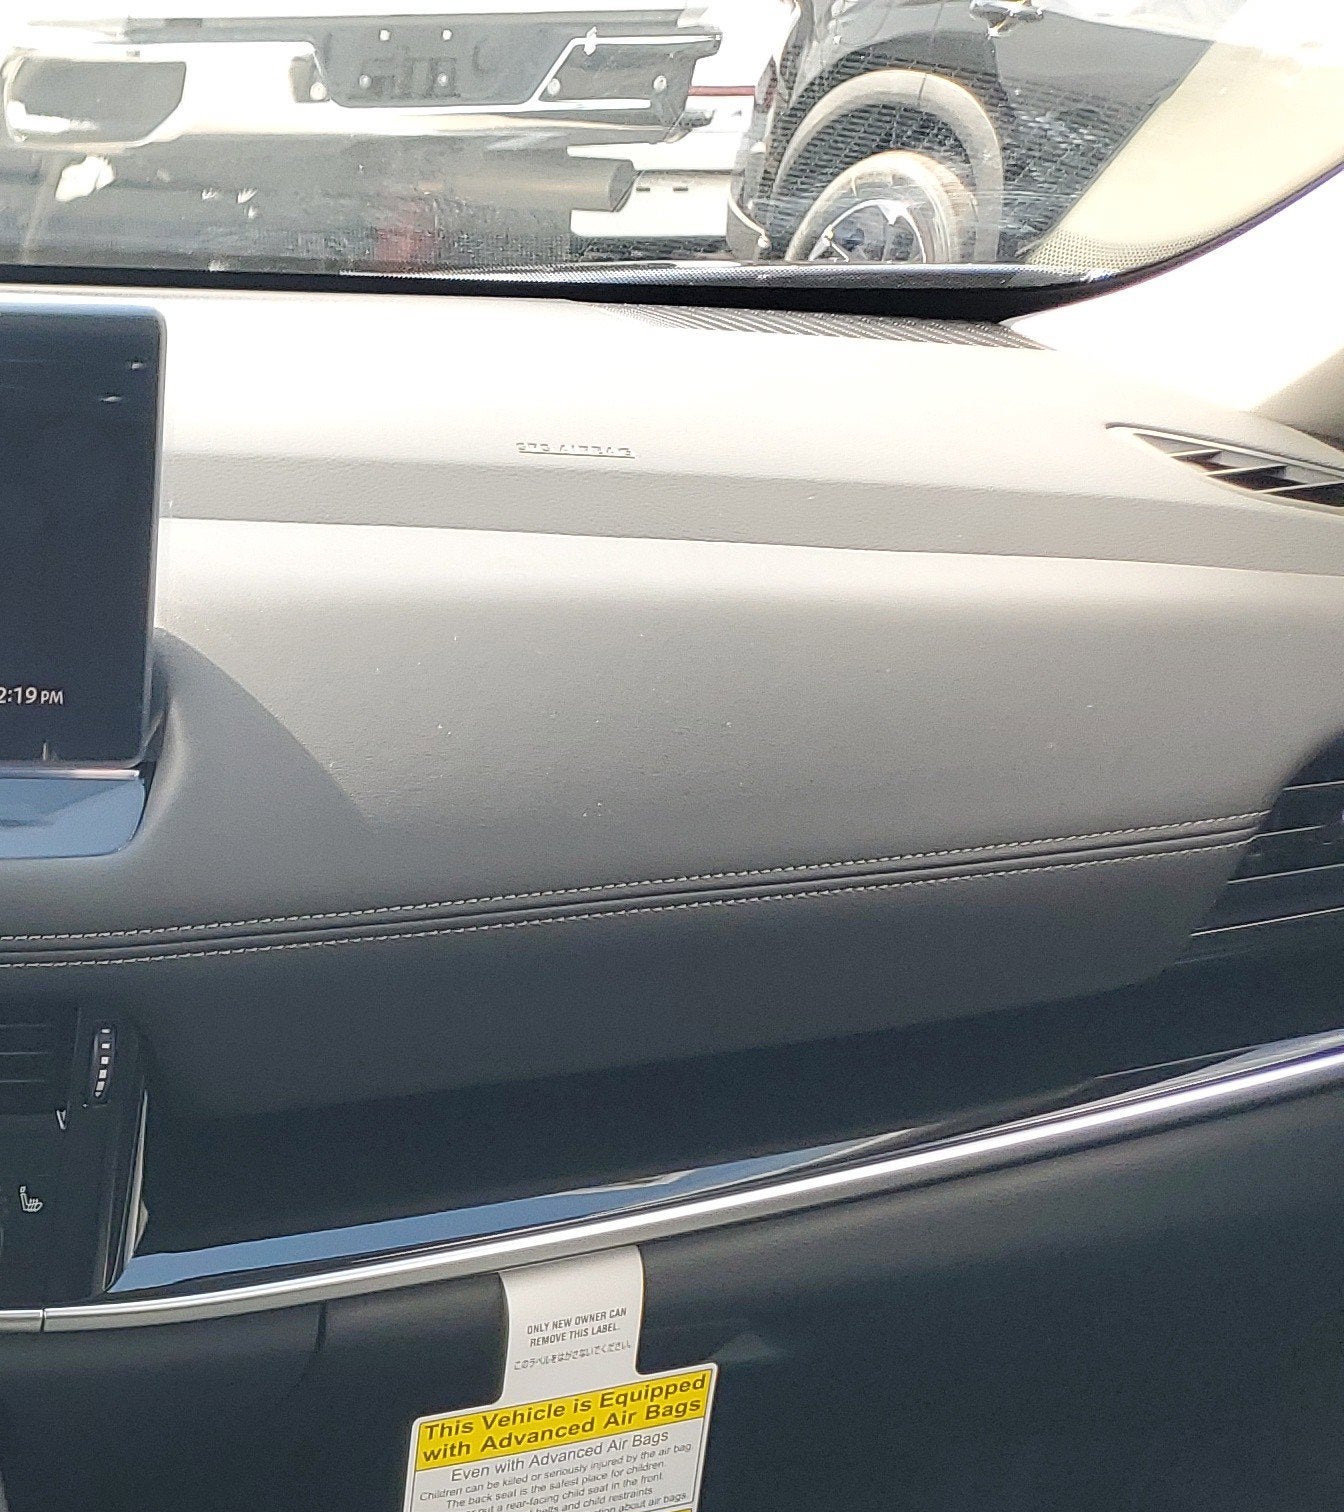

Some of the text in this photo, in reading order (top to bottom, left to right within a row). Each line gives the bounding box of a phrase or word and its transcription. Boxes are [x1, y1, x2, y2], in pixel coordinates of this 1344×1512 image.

[39, 690, 64, 706] PM
[527, 1307, 627, 1334] ONLY NEW OWNER CAN
[529, 1331, 567, 1347] REMOVE
[569, 1327, 589, 1339] THIS
[425, 1373, 707, 1440] This Vehicle is Equipped
[423, 1399, 701, 1461] with Advanced Air Bags
[451, 1431, 669, 1481] Even with Advanced Air Bags
